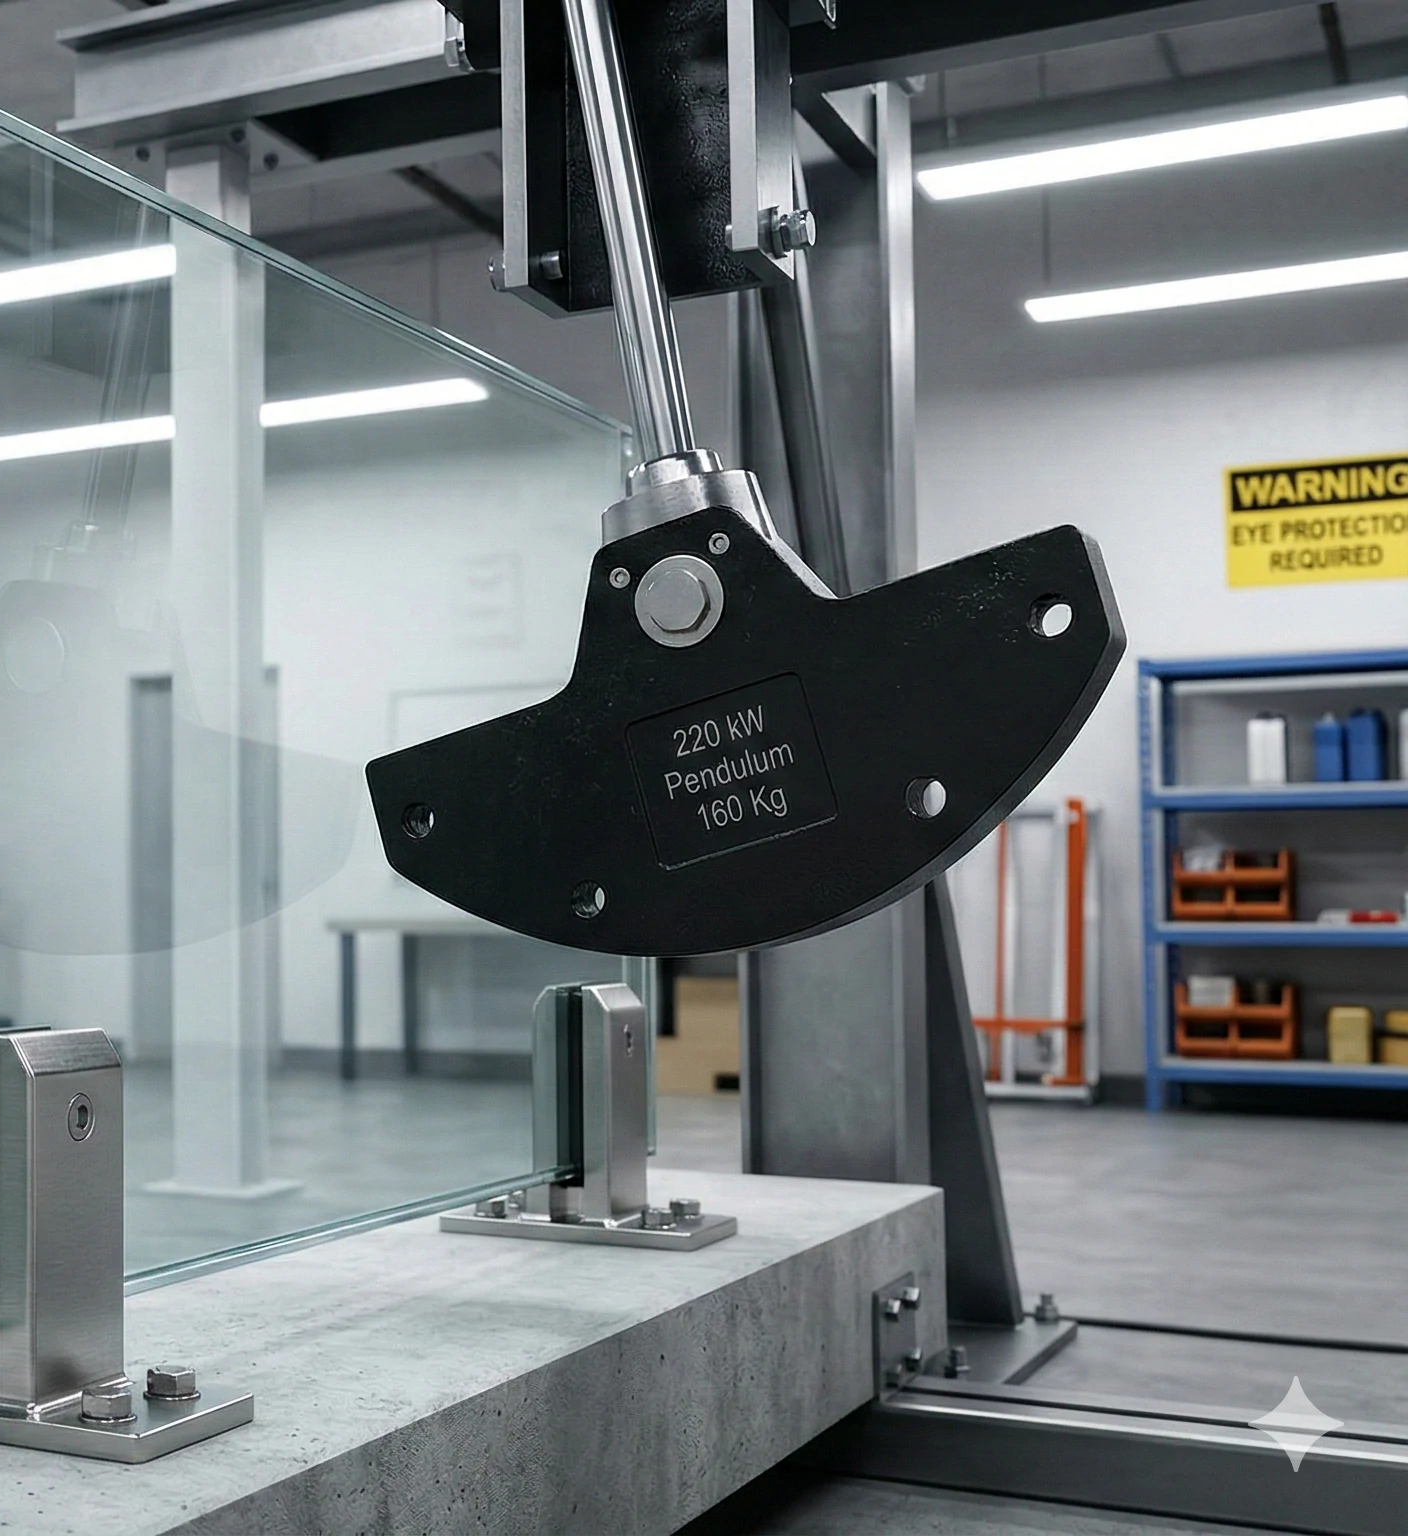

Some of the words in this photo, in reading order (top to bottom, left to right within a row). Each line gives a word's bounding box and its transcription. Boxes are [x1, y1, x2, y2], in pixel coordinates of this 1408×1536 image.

[1235, 464, 1408, 507] WARNING
[1232, 523, 1272, 547] EYE
[1280, 512, 1408, 543] PROTECTIO
[1269, 544, 1383, 572] REQUIRED
[673, 720, 722, 757] 220
[726, 705, 764, 741] kW
[664, 743, 794, 800] Pendulum
[697, 794, 743, 830] 160
[749, 785, 788, 817] Kg
